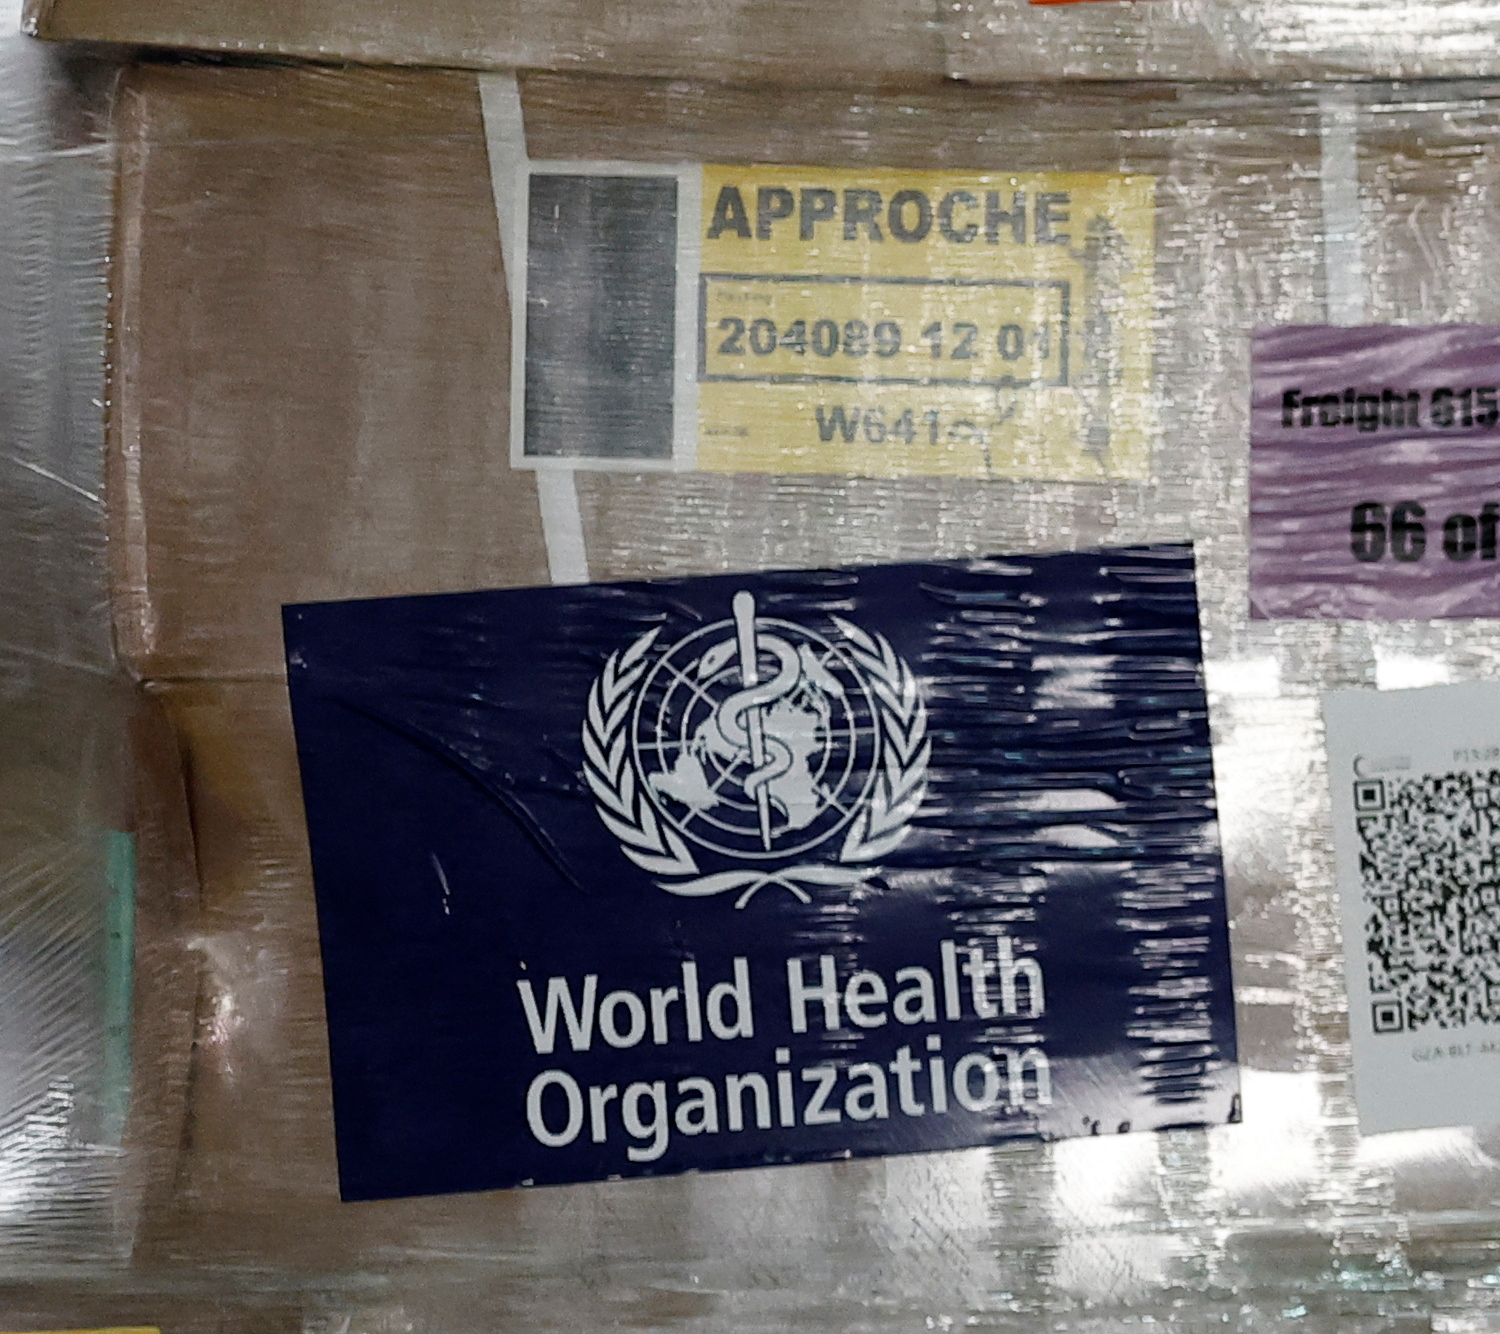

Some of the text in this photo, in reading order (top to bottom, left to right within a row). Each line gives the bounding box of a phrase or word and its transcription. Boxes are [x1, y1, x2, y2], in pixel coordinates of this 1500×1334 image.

[707, 184, 1072, 246] APPROCHE
[921, 321, 979, 361] 12
[1281, 387, 1421, 433] Freight
[1442, 502, 1500, 561] of
[517, 936, 1045, 1055] World Health
[526, 1034, 1053, 1162] Organization
